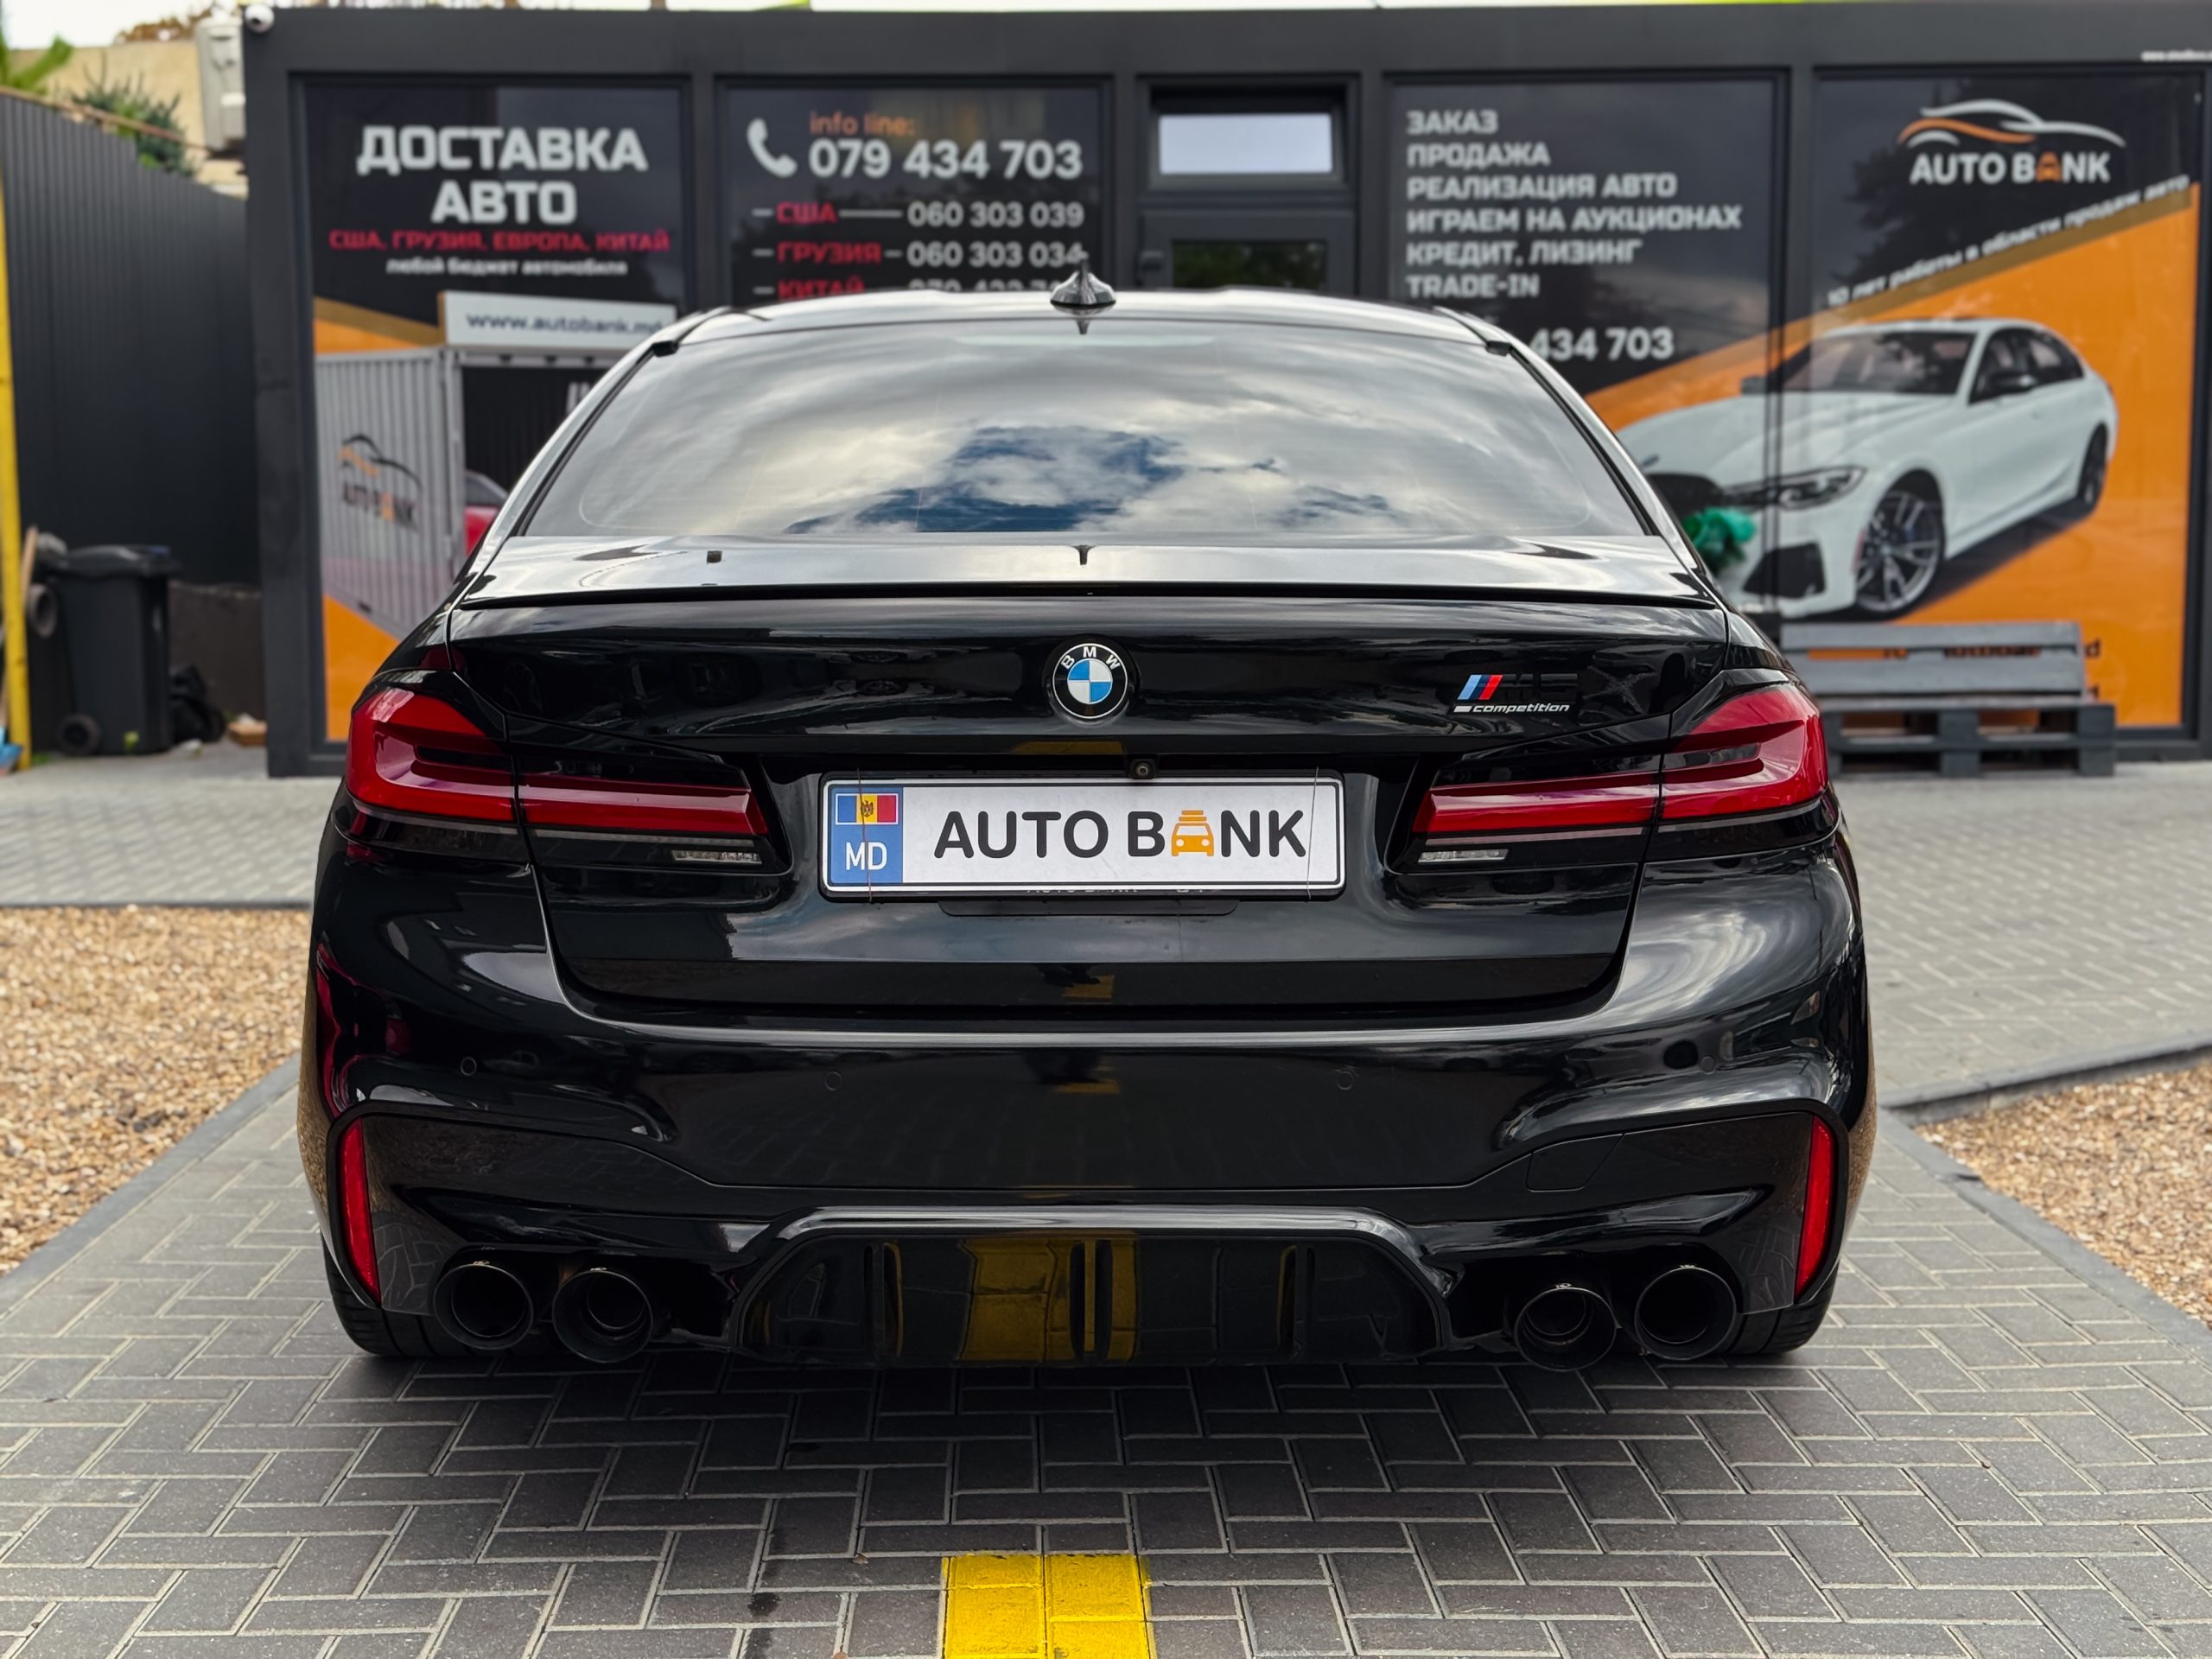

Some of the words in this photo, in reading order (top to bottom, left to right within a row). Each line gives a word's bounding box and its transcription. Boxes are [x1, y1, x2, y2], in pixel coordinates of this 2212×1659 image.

[810, 111, 859, 136] info
[864, 113, 915, 136] line:
[1407, 110, 1498, 135] ЗАКАЗ
[357, 125, 649, 175] ДОСТАВКА
[809, 138, 891, 178] 079
[903, 140, 989, 179] 434
[999, 140, 1083, 180] 703
[1407, 143, 1550, 170] ПРОДАЖА
[1909, 152, 2005, 185] AUTO
[1407, 175, 1596, 201] РЕАЛИЗАЦИЯ
[1601, 173, 1677, 198] АВТО
[430, 180, 578, 225] АВТО
[777, 201, 837, 225] США
[906, 201, 963, 227] 060
[969, 201, 1024, 227] 303
[1030, 201, 1084, 228] 039
[1407, 209, 1518, 232] ИГРАЕМ
[1526, 208, 1565, 231] НА
[1571, 205, 1743, 232] АУКЦИОНАХ
[329, 230, 388, 251] США,
[392, 231, 488, 251] ГРУЗИЯ,
[493, 232, 591, 252] ЕВРОПА,
[595, 228, 671, 251] КИТАЙ
[779, 242, 881, 264] ГРУЗИЯ
[1529, 240, 1642, 264] ЛИЗИНГ
[906, 241, 963, 268] 060
[969, 241, 1024, 268] 303
[1407, 274, 1540, 298] TRADE-IN
[1605, 327, 1674, 359] 703
[1060, 646, 1122, 671] BMW
[1472, 702, 1571, 715] competition
[933, 810, 1109, 859] AUTO
[845, 842, 887, 870] MD
